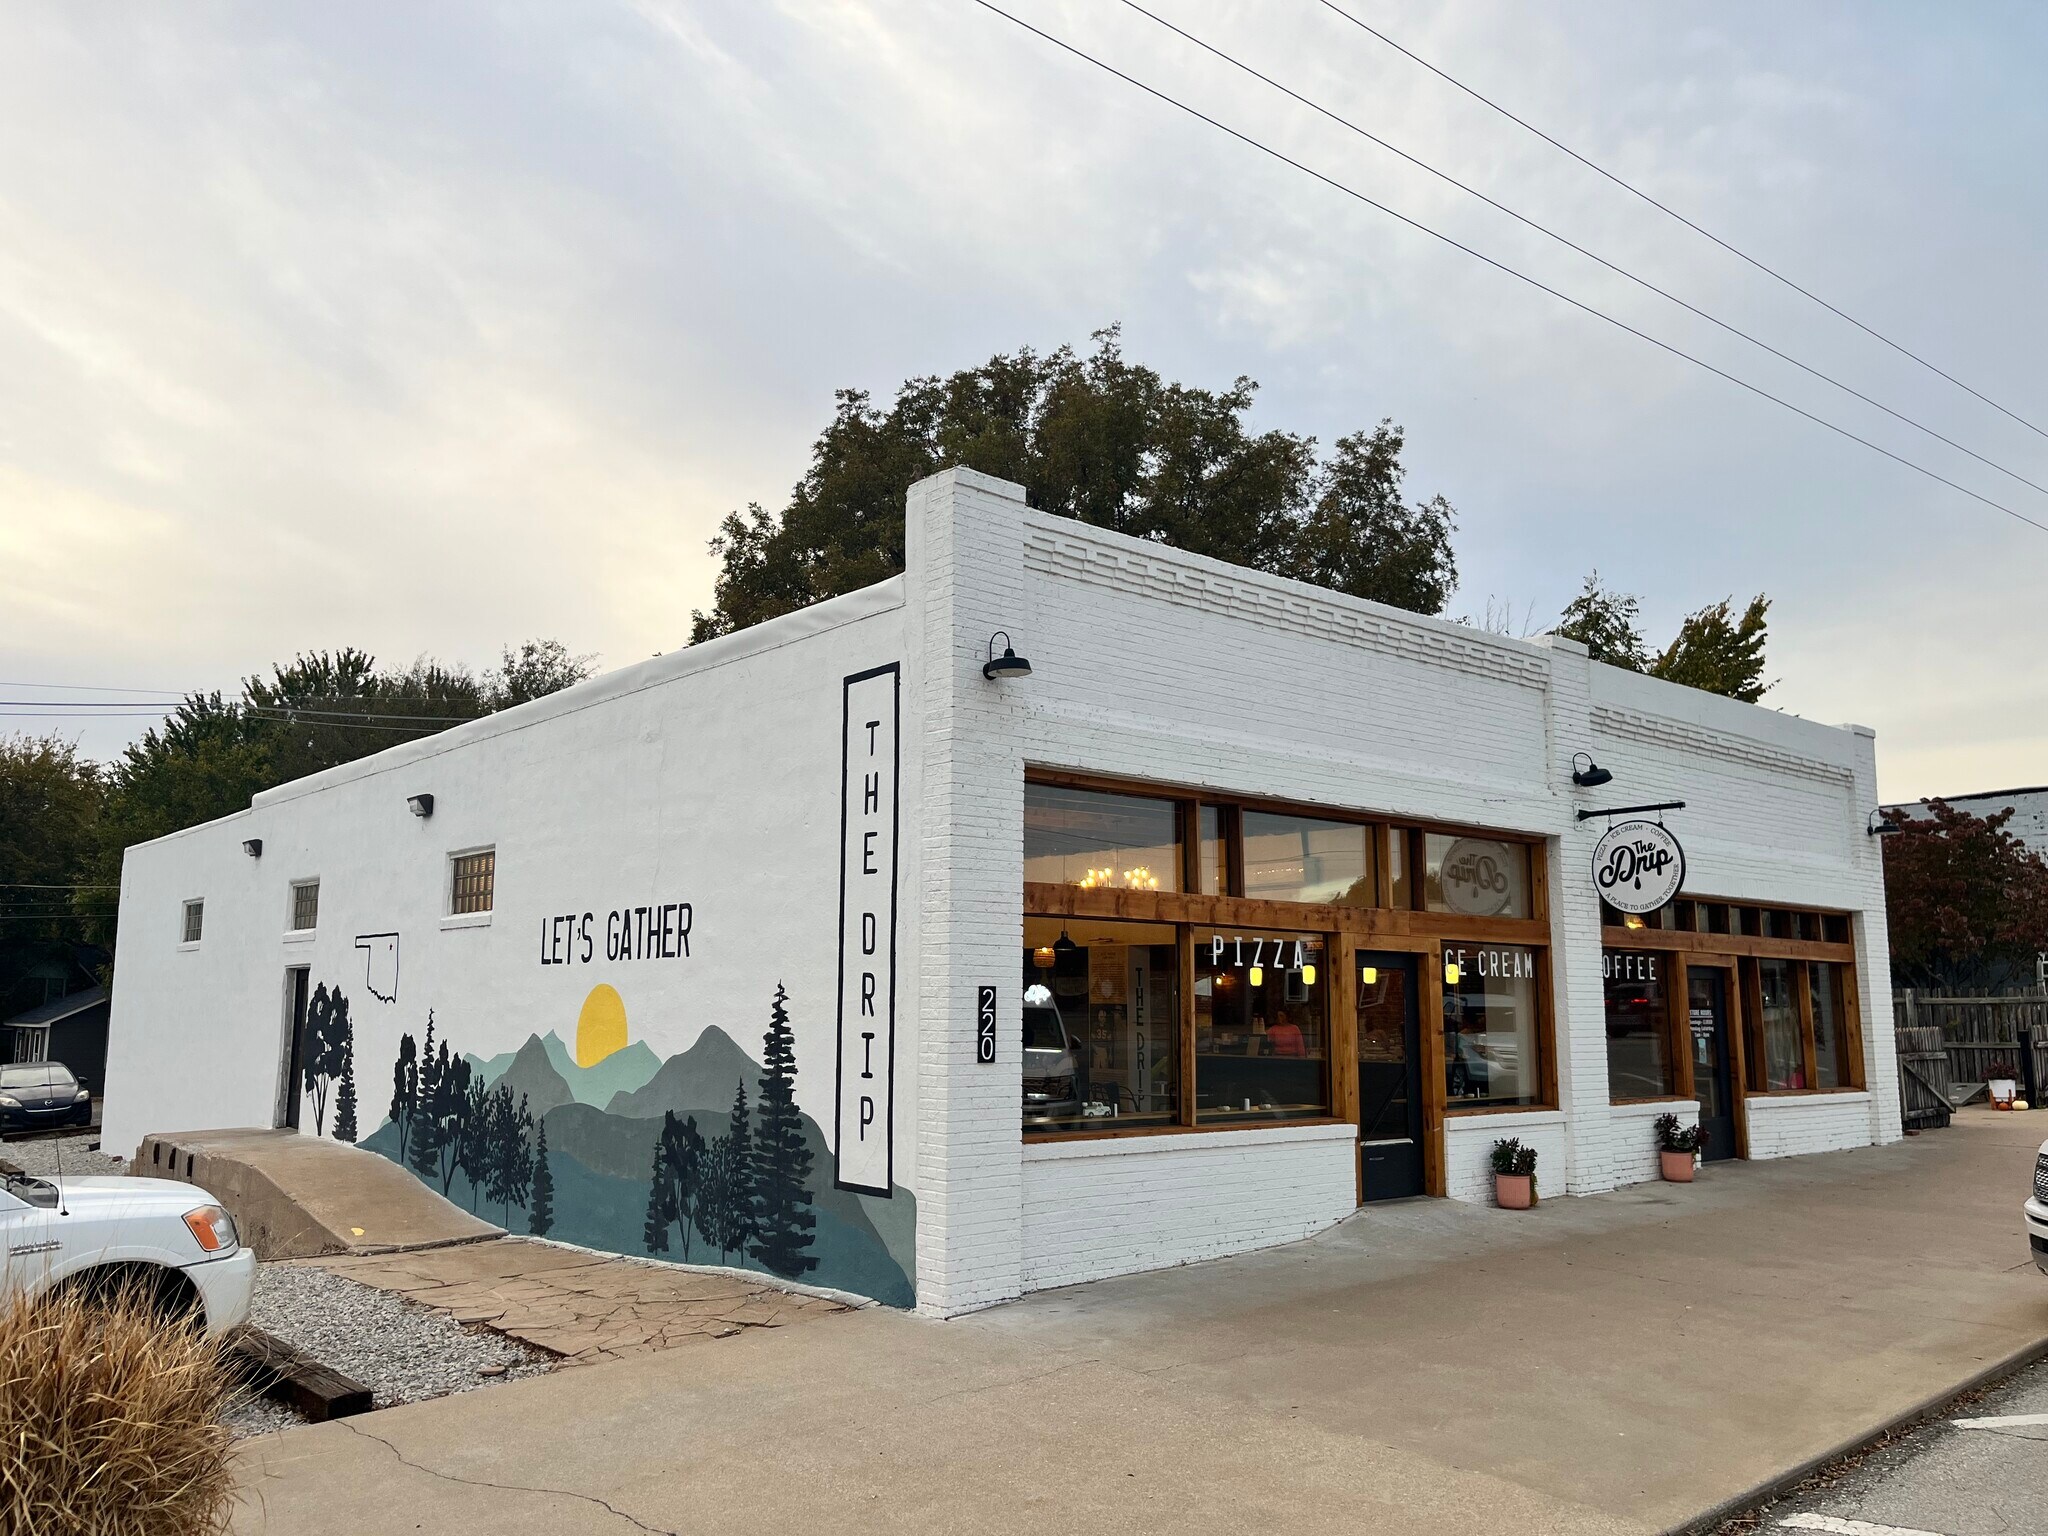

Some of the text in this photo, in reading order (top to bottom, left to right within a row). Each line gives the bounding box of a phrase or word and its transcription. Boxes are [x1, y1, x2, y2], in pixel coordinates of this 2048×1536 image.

[1597, 824, 1671, 861] PIZZA ICE CREAM COFFEE
[1632, 840, 1656, 854] The
[1598, 845, 1673, 888] Drip
[1610, 897, 1629, 909] PLACE
[1639, 895, 1665, 911] GATHER
[1663, 864, 1679, 897] TOGETHER
[541, 902, 693, 965] LET'S GATHER
[860, 720, 880, 1142] THE DRIP
[1212, 935, 1304, 969] PIZZA
[1445, 948, 1533, 978] CE CREAM
[1602, 954, 1657, 981] OFFEE
[1135, 967, 1144, 1026] THE
[982, 988, 994, 1060] 220
